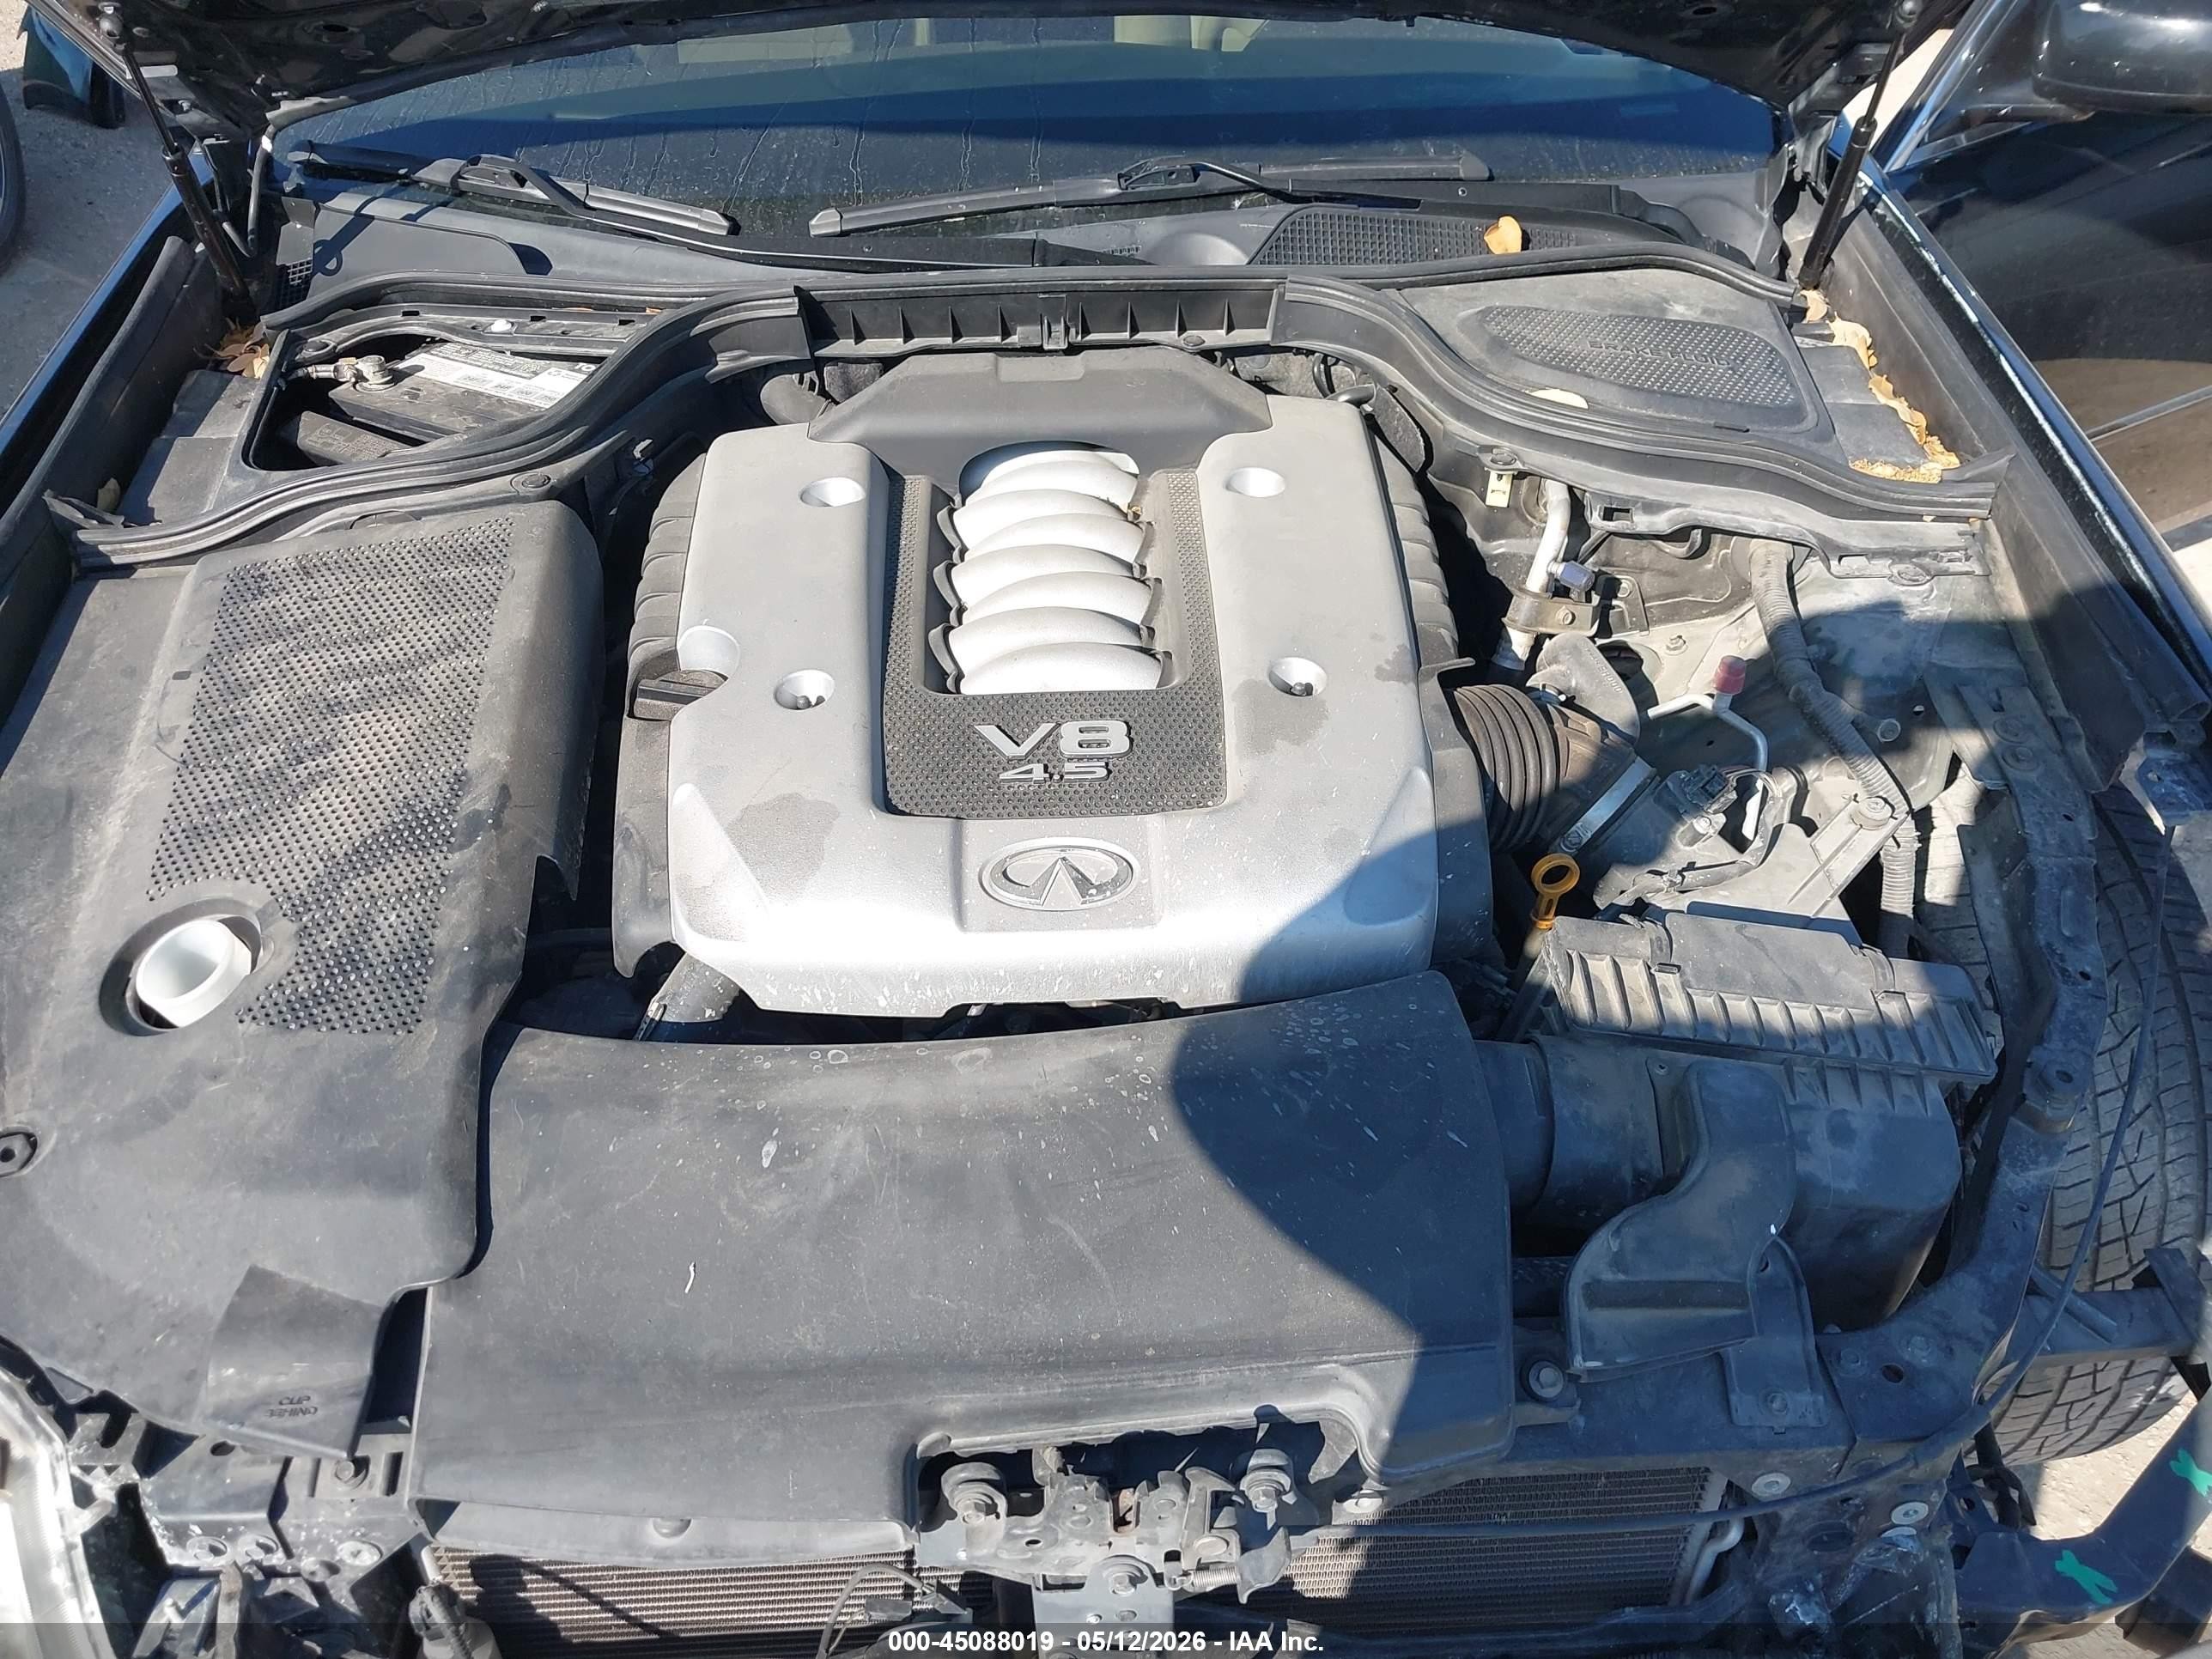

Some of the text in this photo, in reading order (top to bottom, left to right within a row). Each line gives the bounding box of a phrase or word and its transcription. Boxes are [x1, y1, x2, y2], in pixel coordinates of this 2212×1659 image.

[1586, 341, 1731, 367] BRAKE FLUID
[973, 720, 1133, 762] V8
[999, 761, 1110, 785] 4.5
[278, 1395, 311, 1405] CLIP
